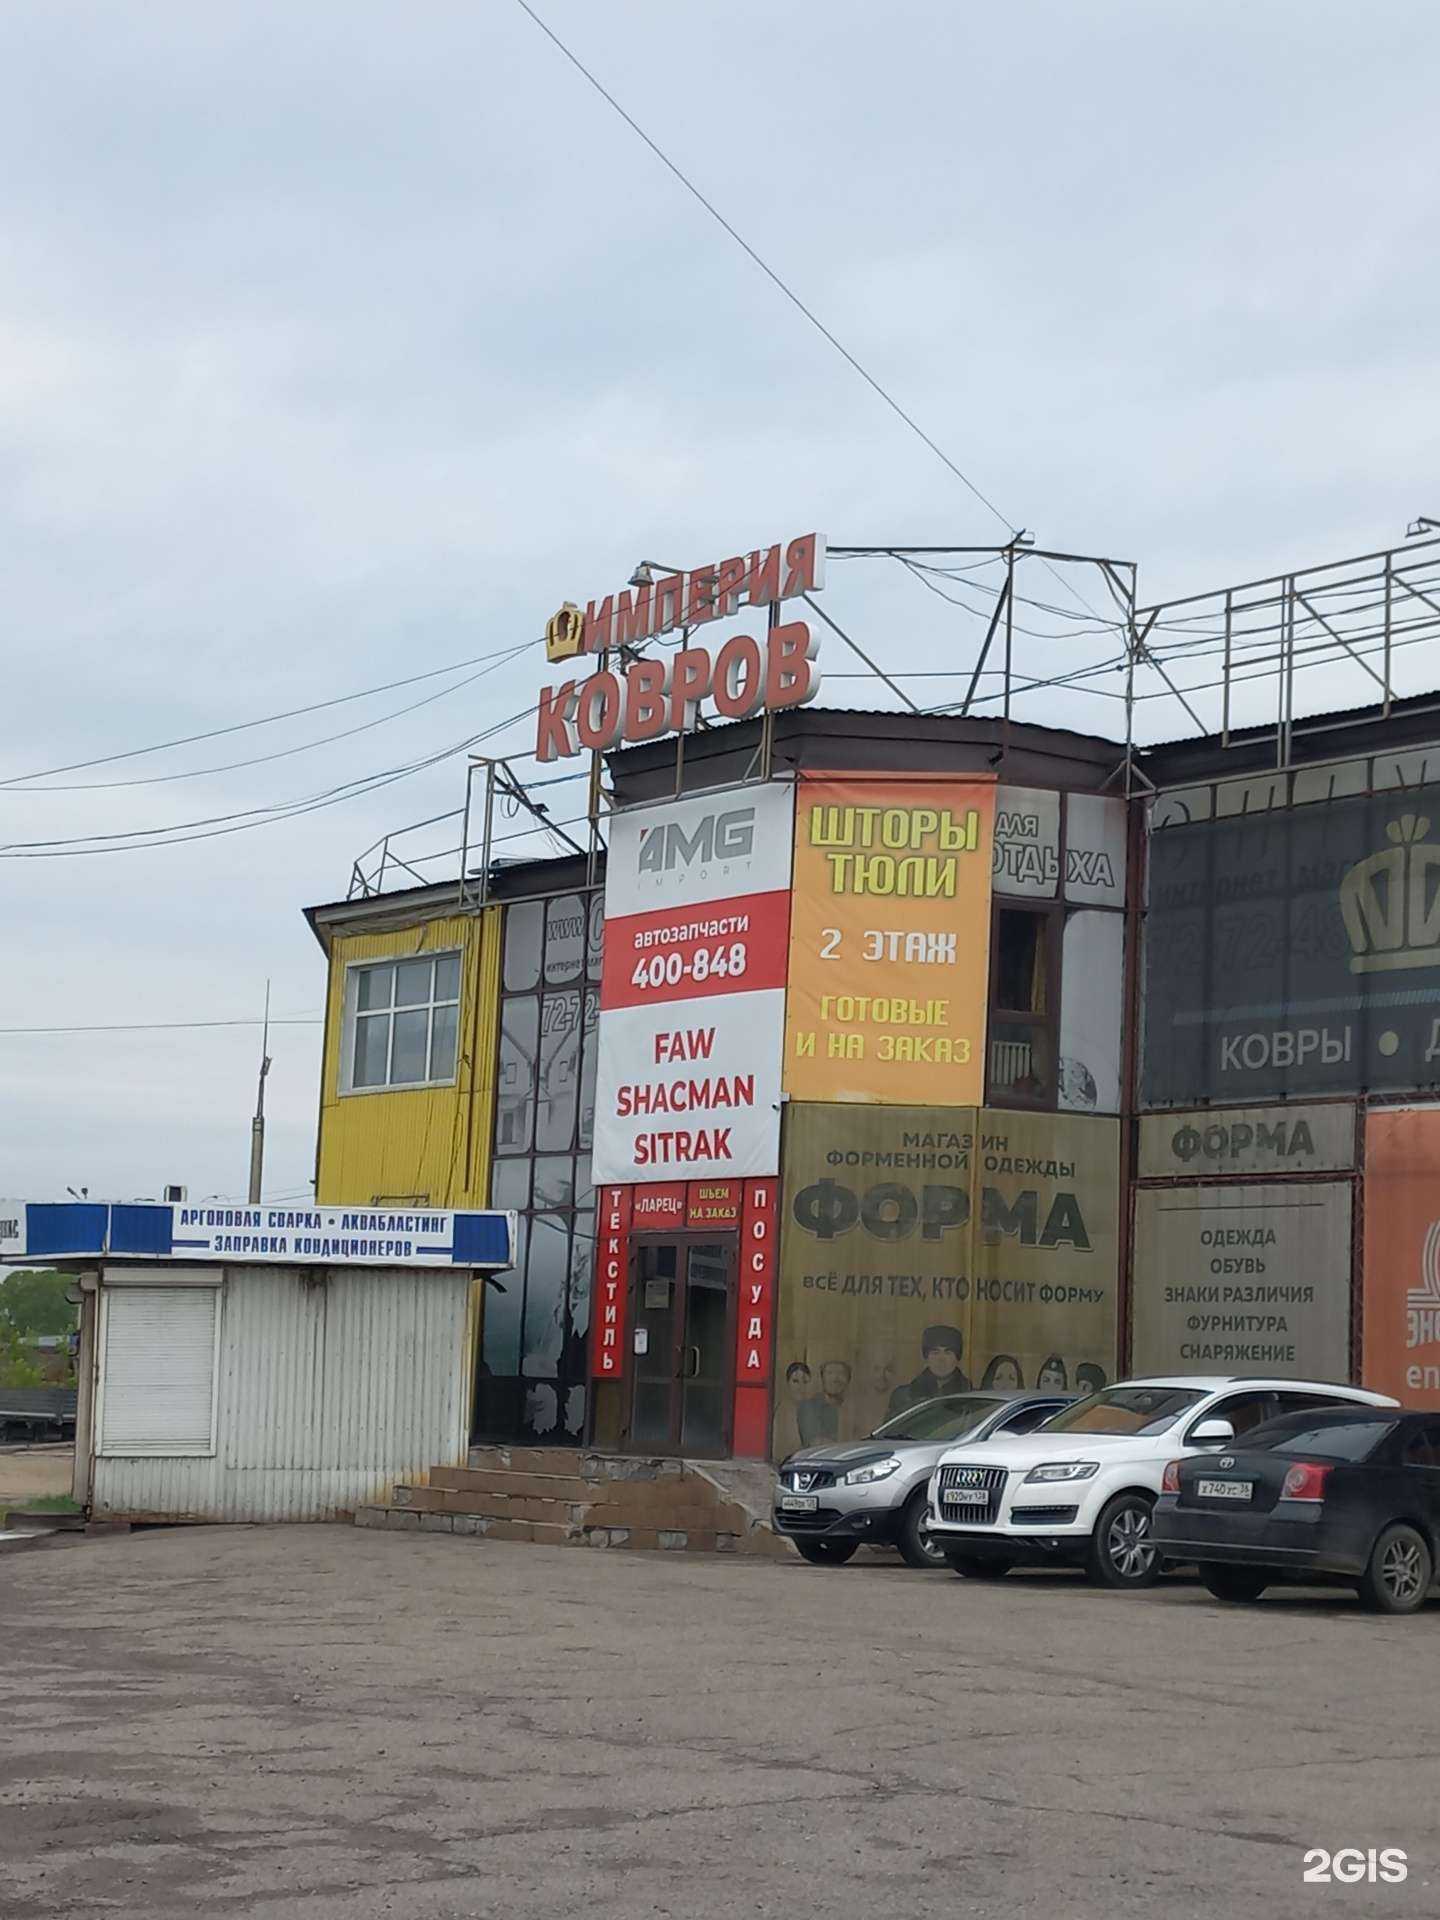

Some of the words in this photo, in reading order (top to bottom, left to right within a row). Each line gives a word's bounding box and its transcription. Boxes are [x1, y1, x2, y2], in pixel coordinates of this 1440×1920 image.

[583, 532, 827, 652] ИМПЕРИЯ
[536, 621, 821, 762] КОВРОВ
[639, 808, 755, 873] AMG
[810, 806, 979, 851] ШТОРЫ
[826, 853, 957, 897] ТЮЛИ
[634, 915, 749, 949] автозапчасти
[819, 928, 842, 960] 2
[863, 930, 957, 964] ЭТАЖ
[631, 943, 746, 989] 400-848
[819, 995, 950, 1025] ГОТОВЫЕ
[654, 1027, 717, 1064] FAW
[796, 1031, 816, 1057] И
[829, 1032, 864, 1060] НА
[878, 1036, 970, 1063] ЗАКАЗ
[1220, 1026, 1351, 1071] КОВРЫ
[616, 1075, 755, 1118] SHACMAN
[633, 1128, 733, 1165] SITRAK
[903, 1132, 1008, 1152] МАГАЗИН
[1171, 1119, 1315, 1162] ФОРМА
[826, 1150, 969, 1171] ФОРМЕННОЙ
[984, 1155, 1076, 1179] ОДЕЖДЫ
[180, 1208, 262, 1228] АРГОНОВАЯ
[268, 1212, 322, 1230] СВАРКА
[341, 1214, 448, 1234] АКВАБЛАСТИНГ
[792, 1177, 1094, 1252] ФОРМА
[214, 1235, 287, 1253] ЗАПРАВКА
[294, 1238, 412, 1257] КОНДИЦИОНЕРОВ
[1201, 1229, 1276, 1248] ОДЕЖДА
[602, 1189, 622, 1370] ТЕКСТИЛЬ
[747, 1189, 767, 1369] ПОСУДА
[1210, 1258, 1266, 1274] ОБУВЬ
[841, 1275, 883, 1295] ДЛЯ
[888, 1276, 926, 1301] ТЕХ,
[932, 1277, 971, 1300] КТО
[976, 1278, 1035, 1303] НОСИТ
[1039, 1283, 1104, 1304] ФОРМУ
[1164, 1286, 1219, 1303] ЗНАКИ
[1223, 1286, 1314, 1303] РАЗЛИЧИЯ
[1187, 1315, 1288, 1333] ФУРНИТУРА
[1179, 1343, 1295, 1362] СНАРЯЖЕНИЕ
